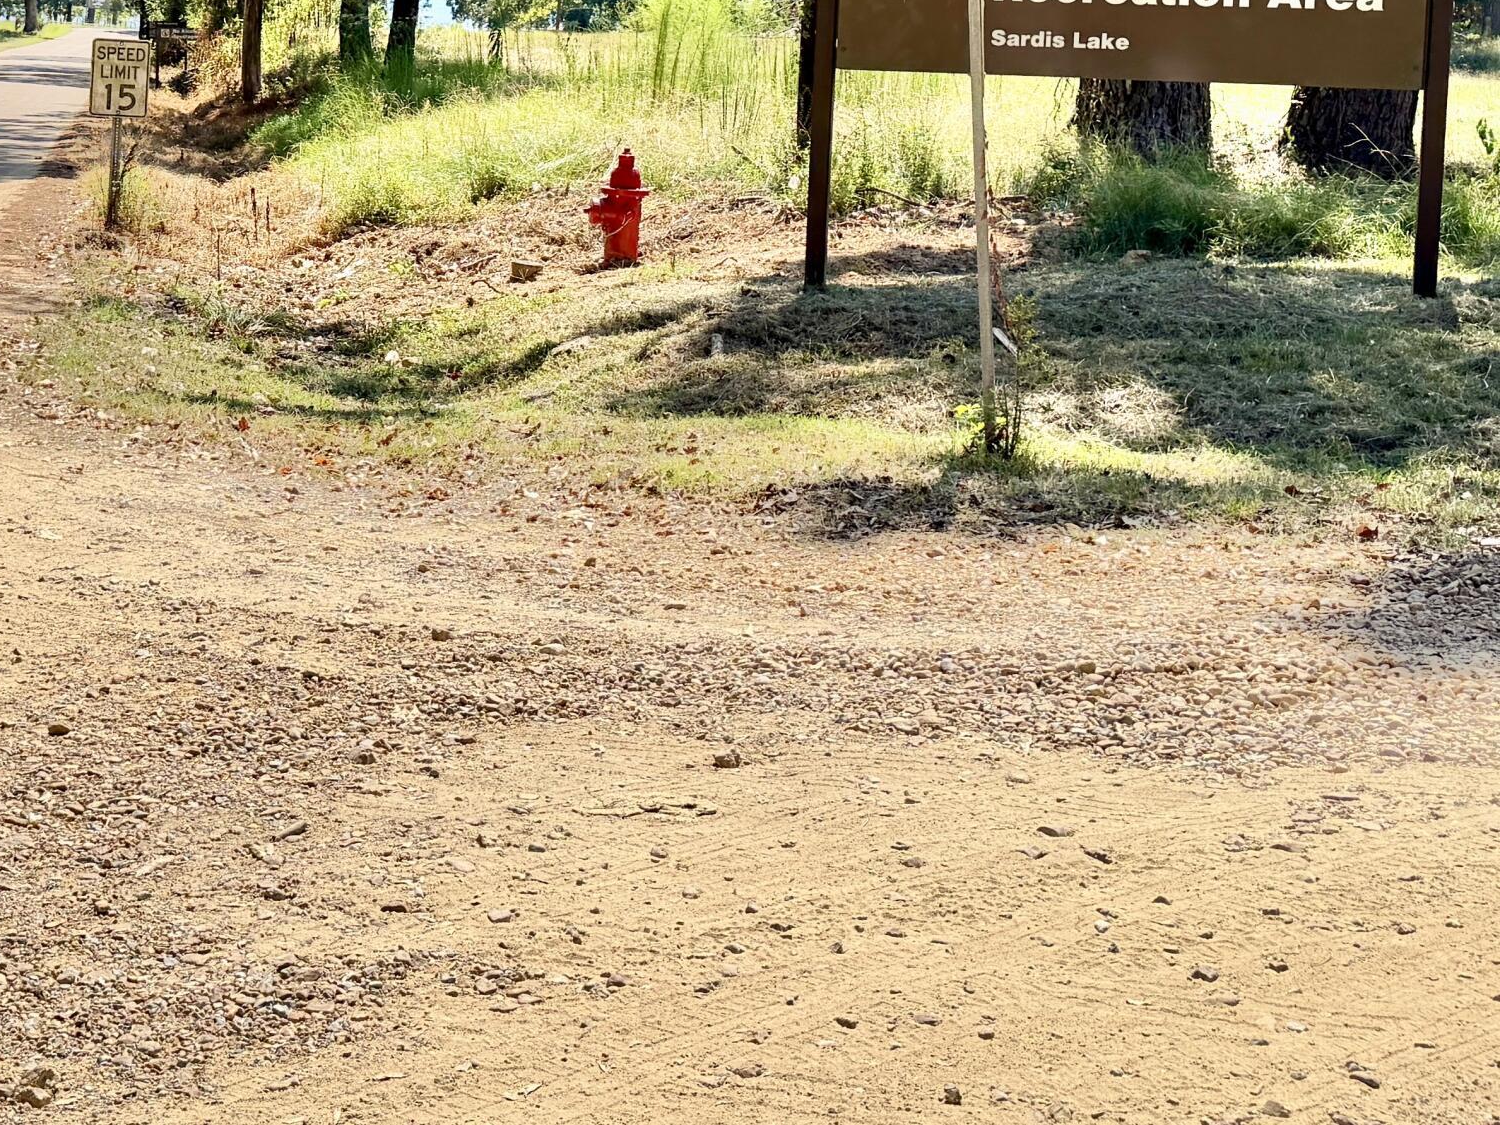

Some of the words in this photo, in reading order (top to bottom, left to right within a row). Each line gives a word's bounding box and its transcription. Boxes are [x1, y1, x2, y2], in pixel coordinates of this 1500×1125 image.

[991, 29, 1065, 49] Sardis
[1073, 32, 1130, 51] Lake
[96, 46, 146, 62] SPEED
[100, 64, 141, 80] LIMIT
[105, 83, 136, 111] 15
